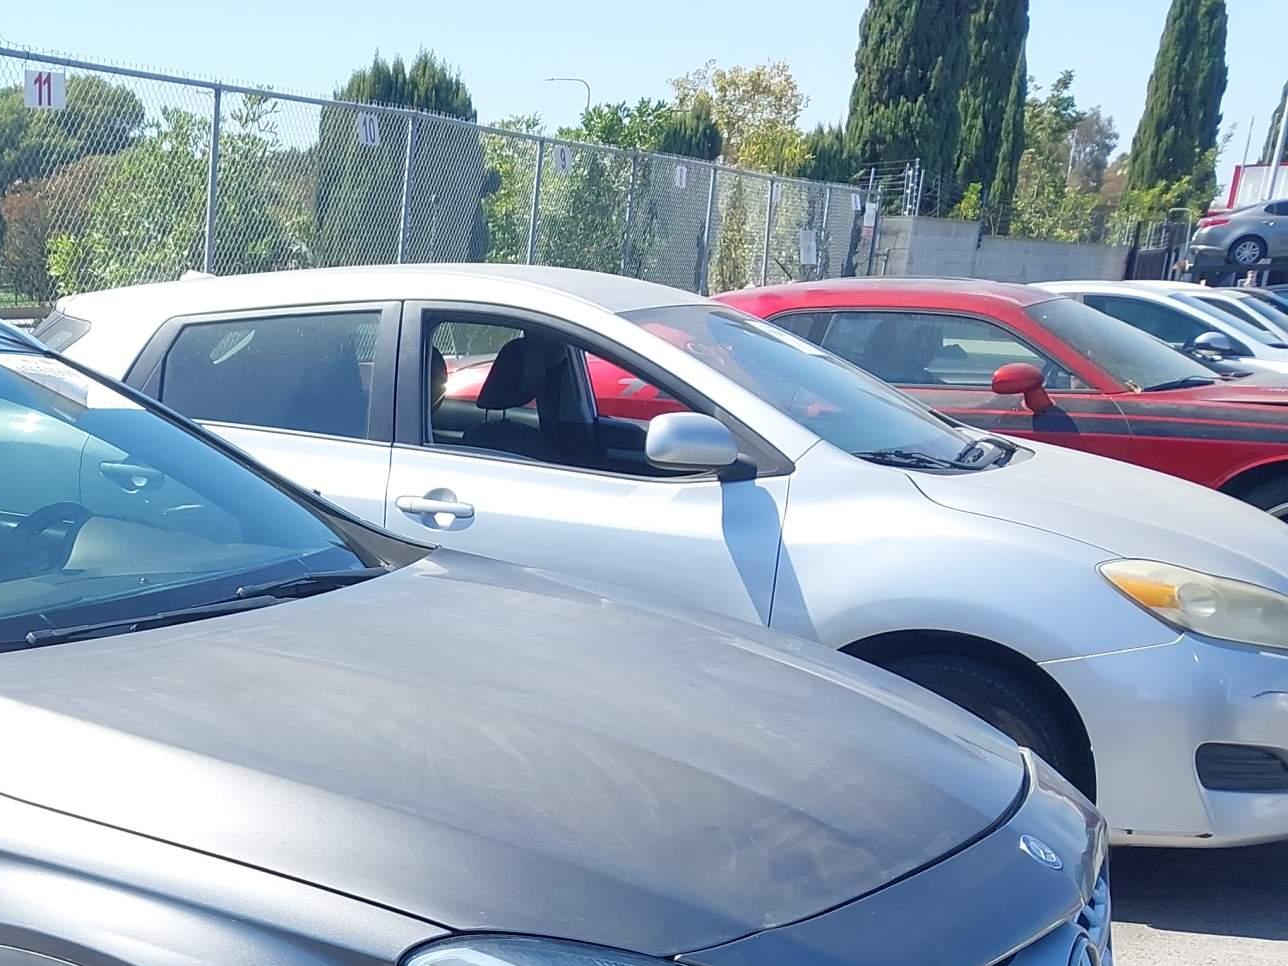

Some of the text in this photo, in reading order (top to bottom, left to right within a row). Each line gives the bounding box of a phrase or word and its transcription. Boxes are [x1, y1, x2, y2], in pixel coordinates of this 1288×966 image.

[34, 72, 52, 107] 11
[362, 116, 376, 144] 10
[560, 148, 567, 170] 9
